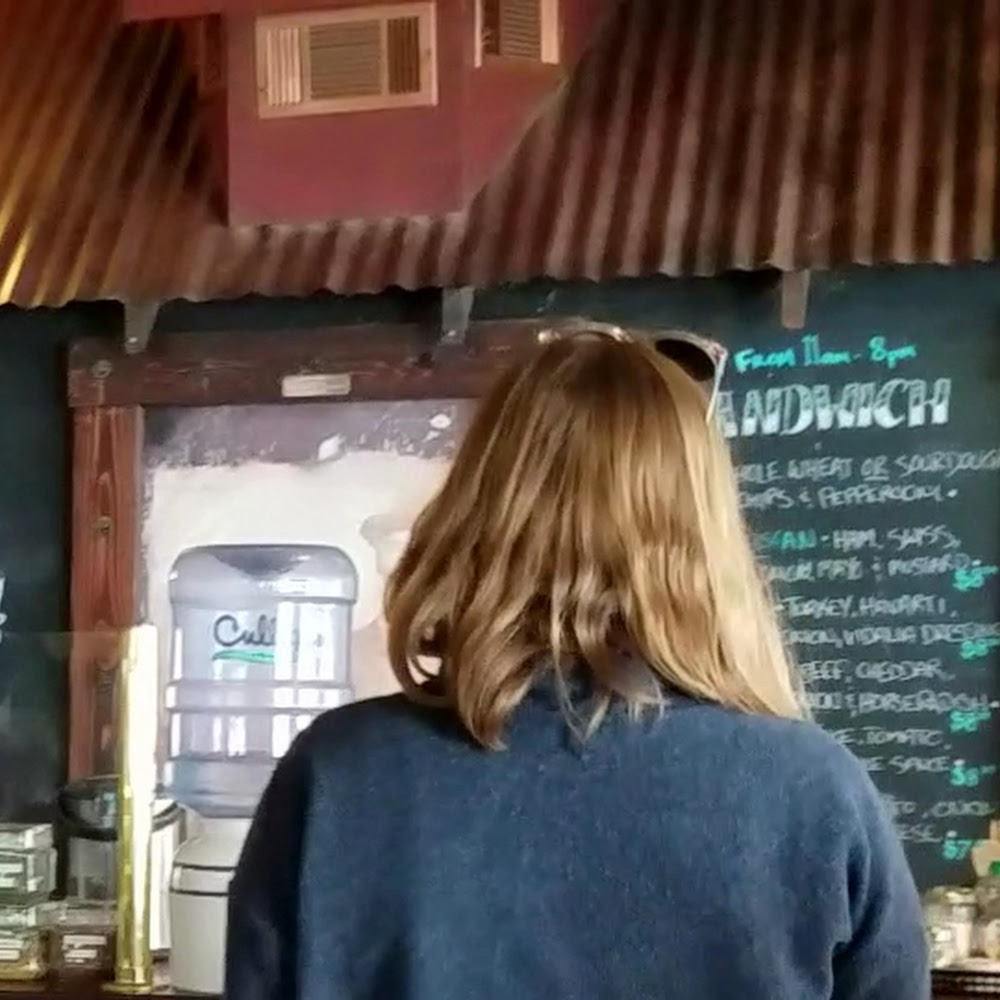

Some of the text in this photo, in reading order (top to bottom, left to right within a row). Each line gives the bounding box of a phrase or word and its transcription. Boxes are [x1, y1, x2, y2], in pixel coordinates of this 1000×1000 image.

[715, 377, 951, 438] ANDWICH
[787, 457, 853, 483] WHEAT
[861, 455, 890, 481] OR
